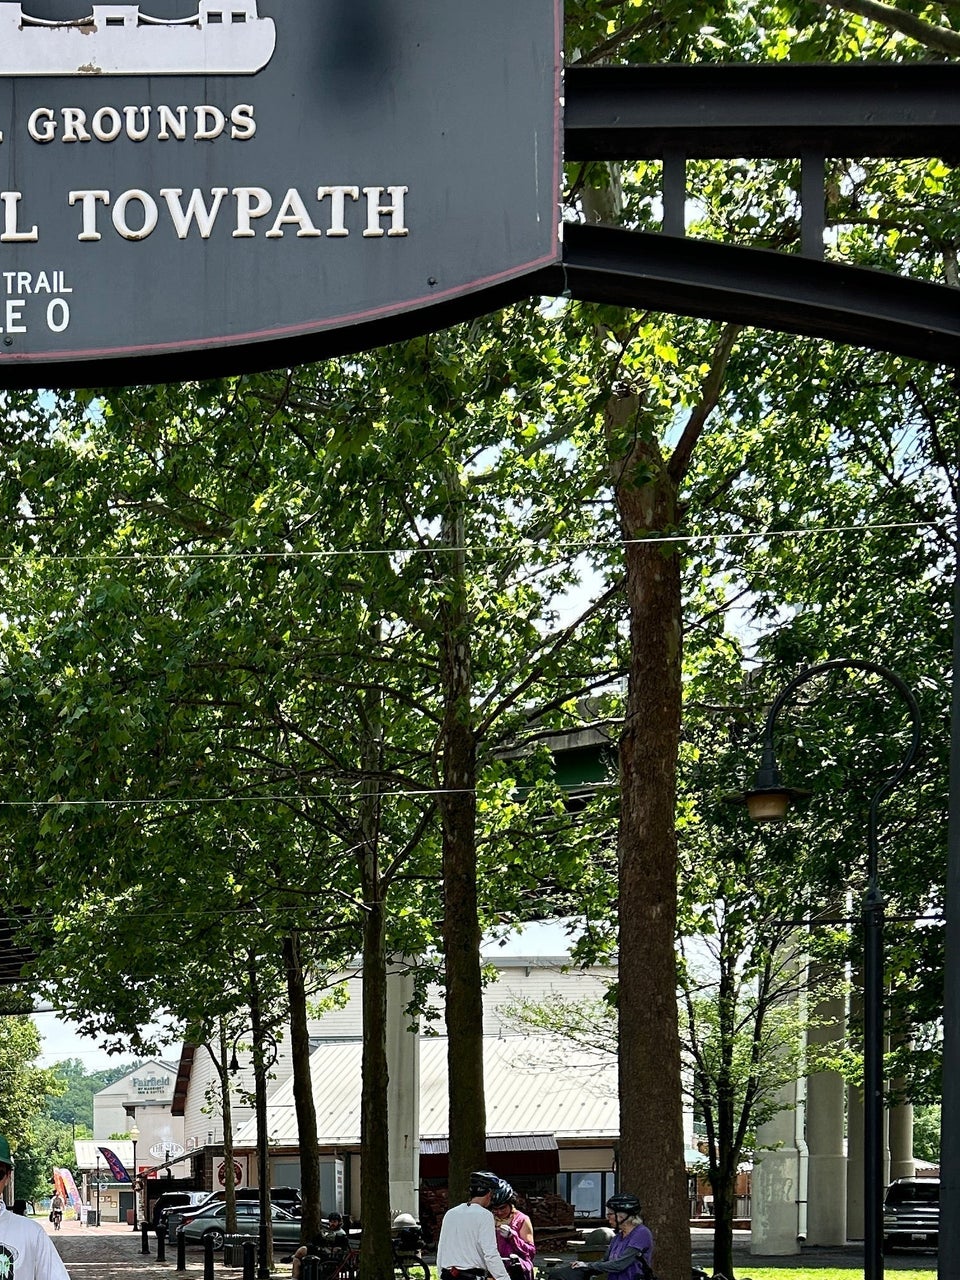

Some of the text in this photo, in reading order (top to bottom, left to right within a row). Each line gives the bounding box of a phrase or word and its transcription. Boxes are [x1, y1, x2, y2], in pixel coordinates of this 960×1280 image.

[27, 105, 257, 141] GROUNDS
[68, 185, 409, 241] TOWPATH
[2, 270, 73, 294] TRAIL
[132, 1076, 170, 1087] Fairfield
